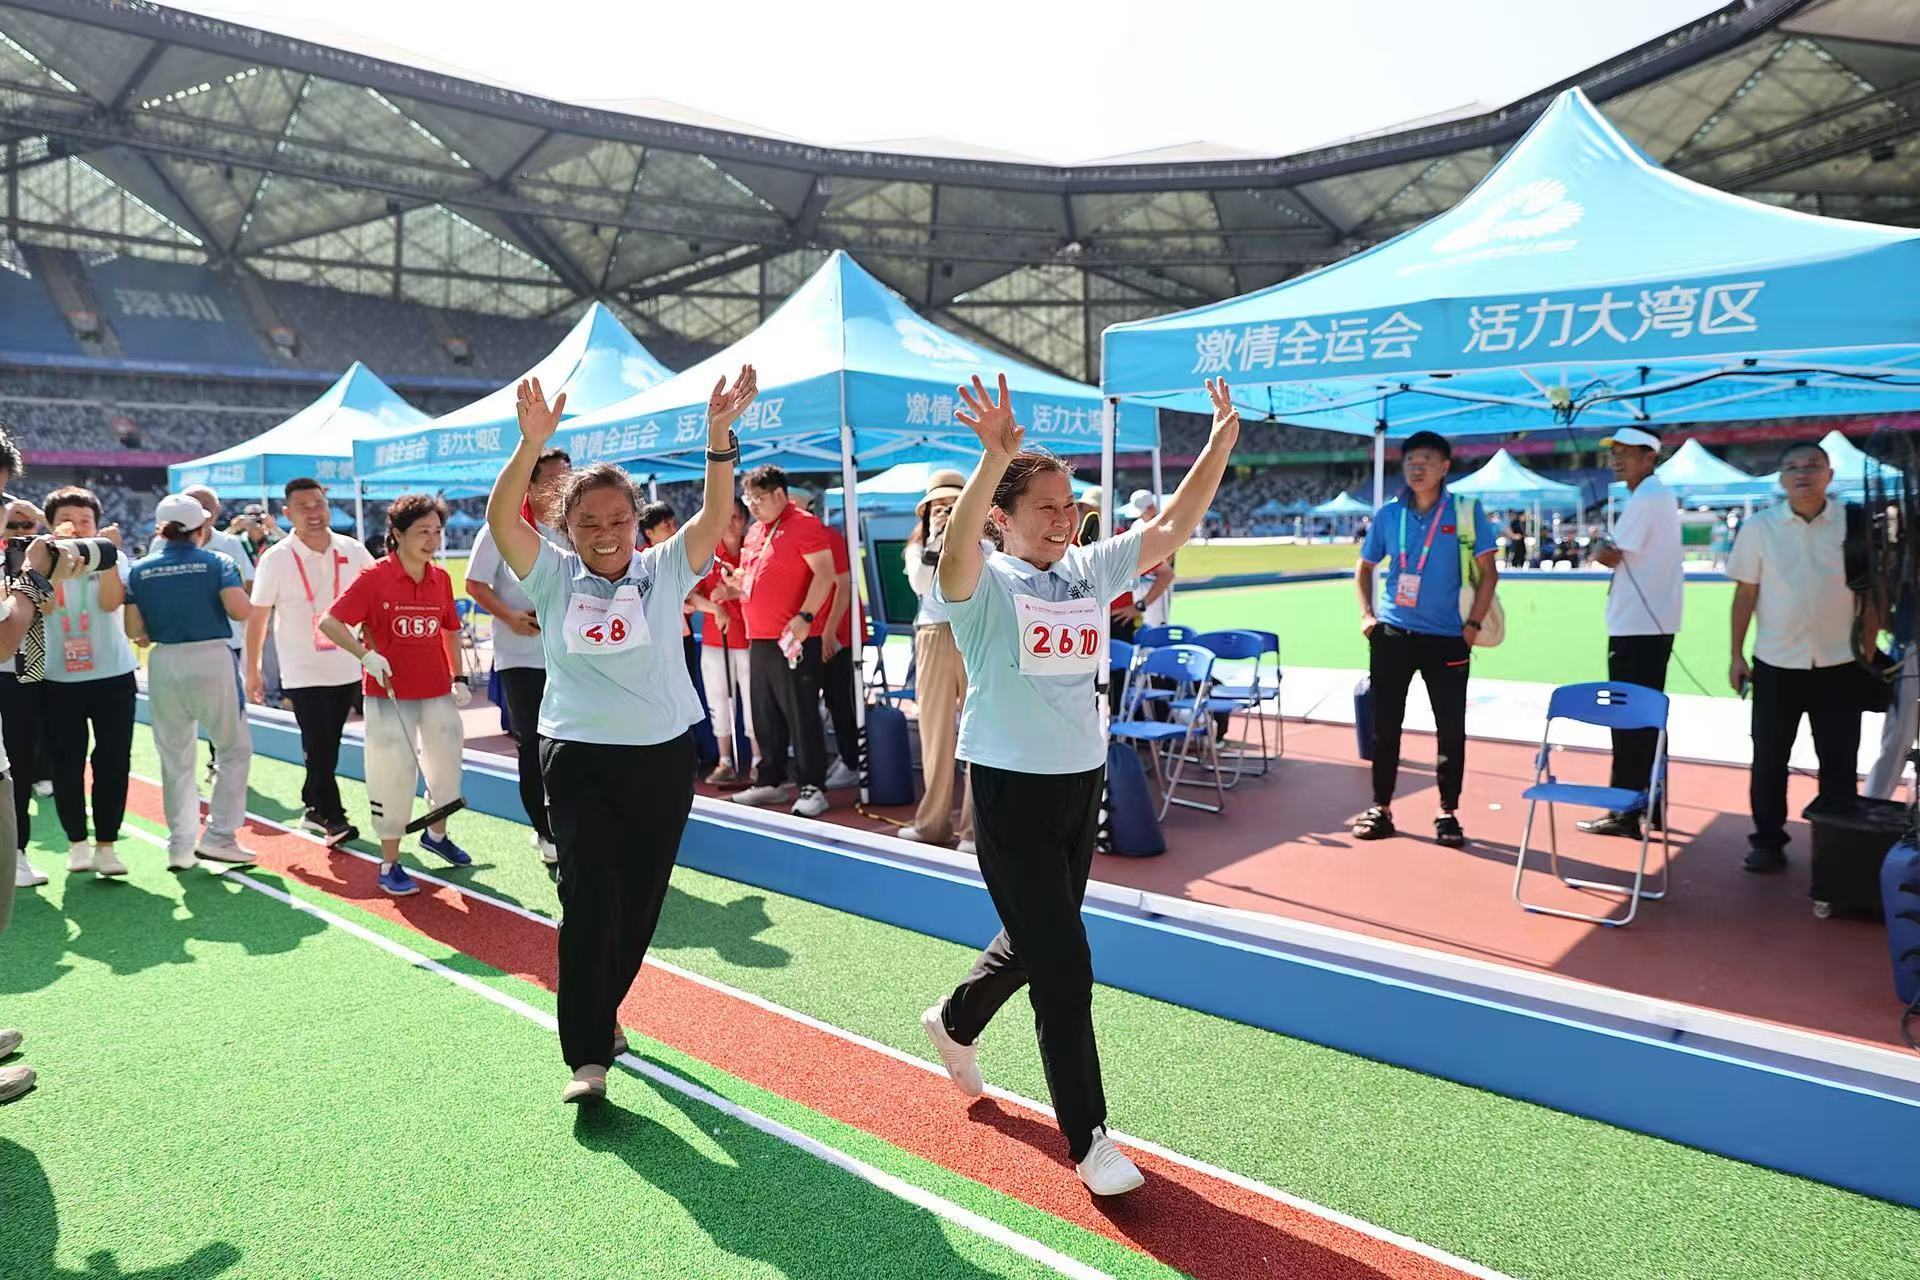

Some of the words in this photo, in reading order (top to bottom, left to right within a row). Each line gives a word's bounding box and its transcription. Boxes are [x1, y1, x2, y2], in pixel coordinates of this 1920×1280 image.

[1192, 311, 1423, 375] 激情全运会
[1463, 280, 1766, 353] 活力大湾区
[674, 398, 785, 442] 活湾区
[1030, 403, 1121, 438] 活力大湾
